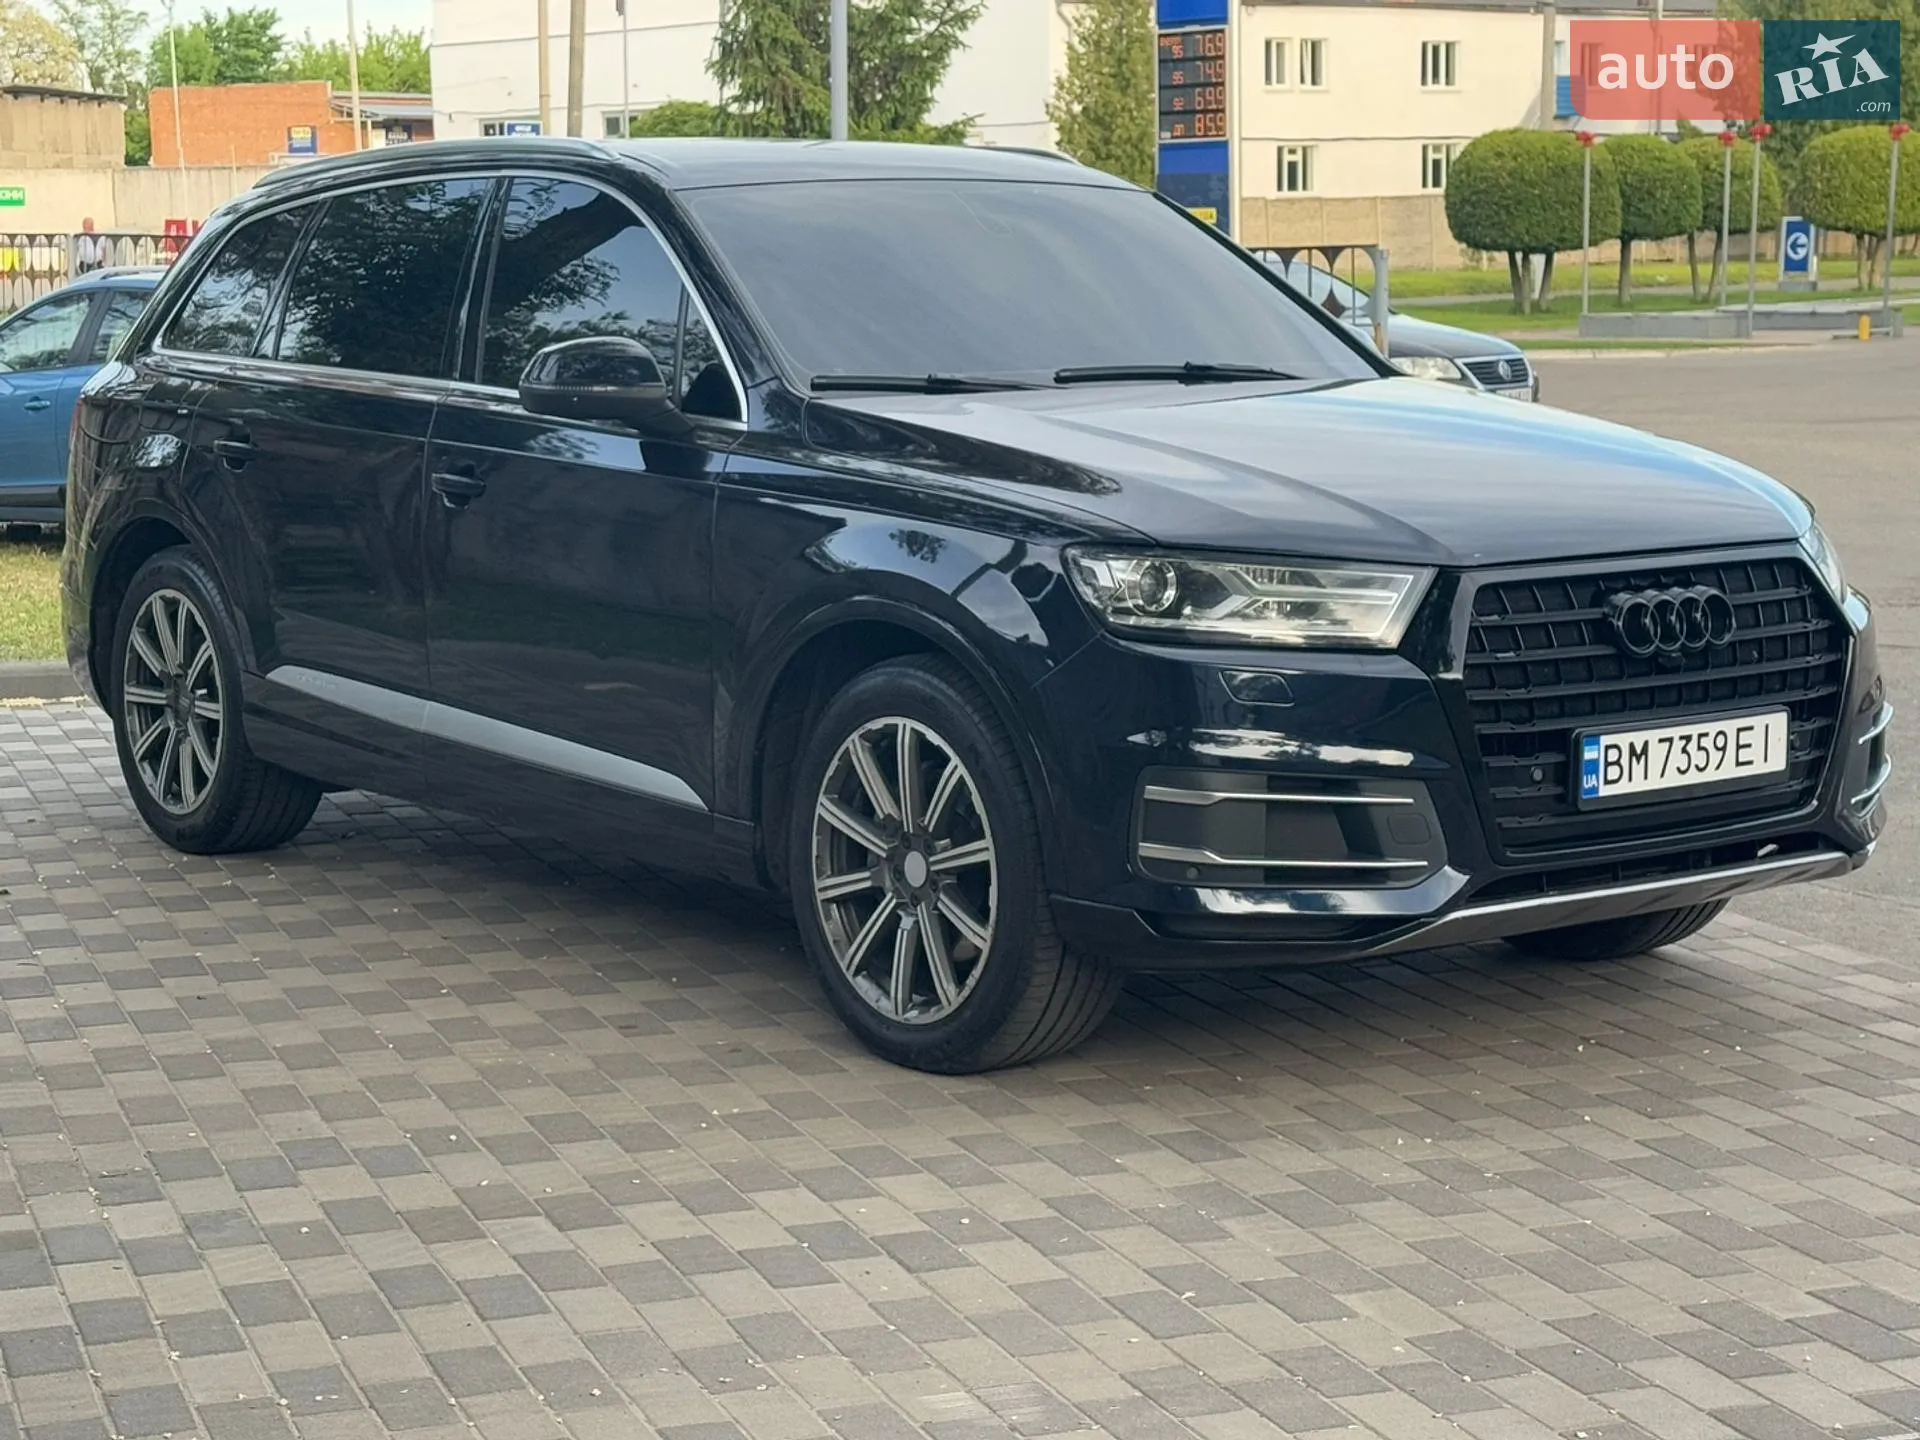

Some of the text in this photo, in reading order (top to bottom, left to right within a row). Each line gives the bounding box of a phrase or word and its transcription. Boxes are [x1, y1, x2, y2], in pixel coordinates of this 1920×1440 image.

[1603, 723, 1770, 786] BM 7359 EI
[1583, 773, 1598, 788] UA
